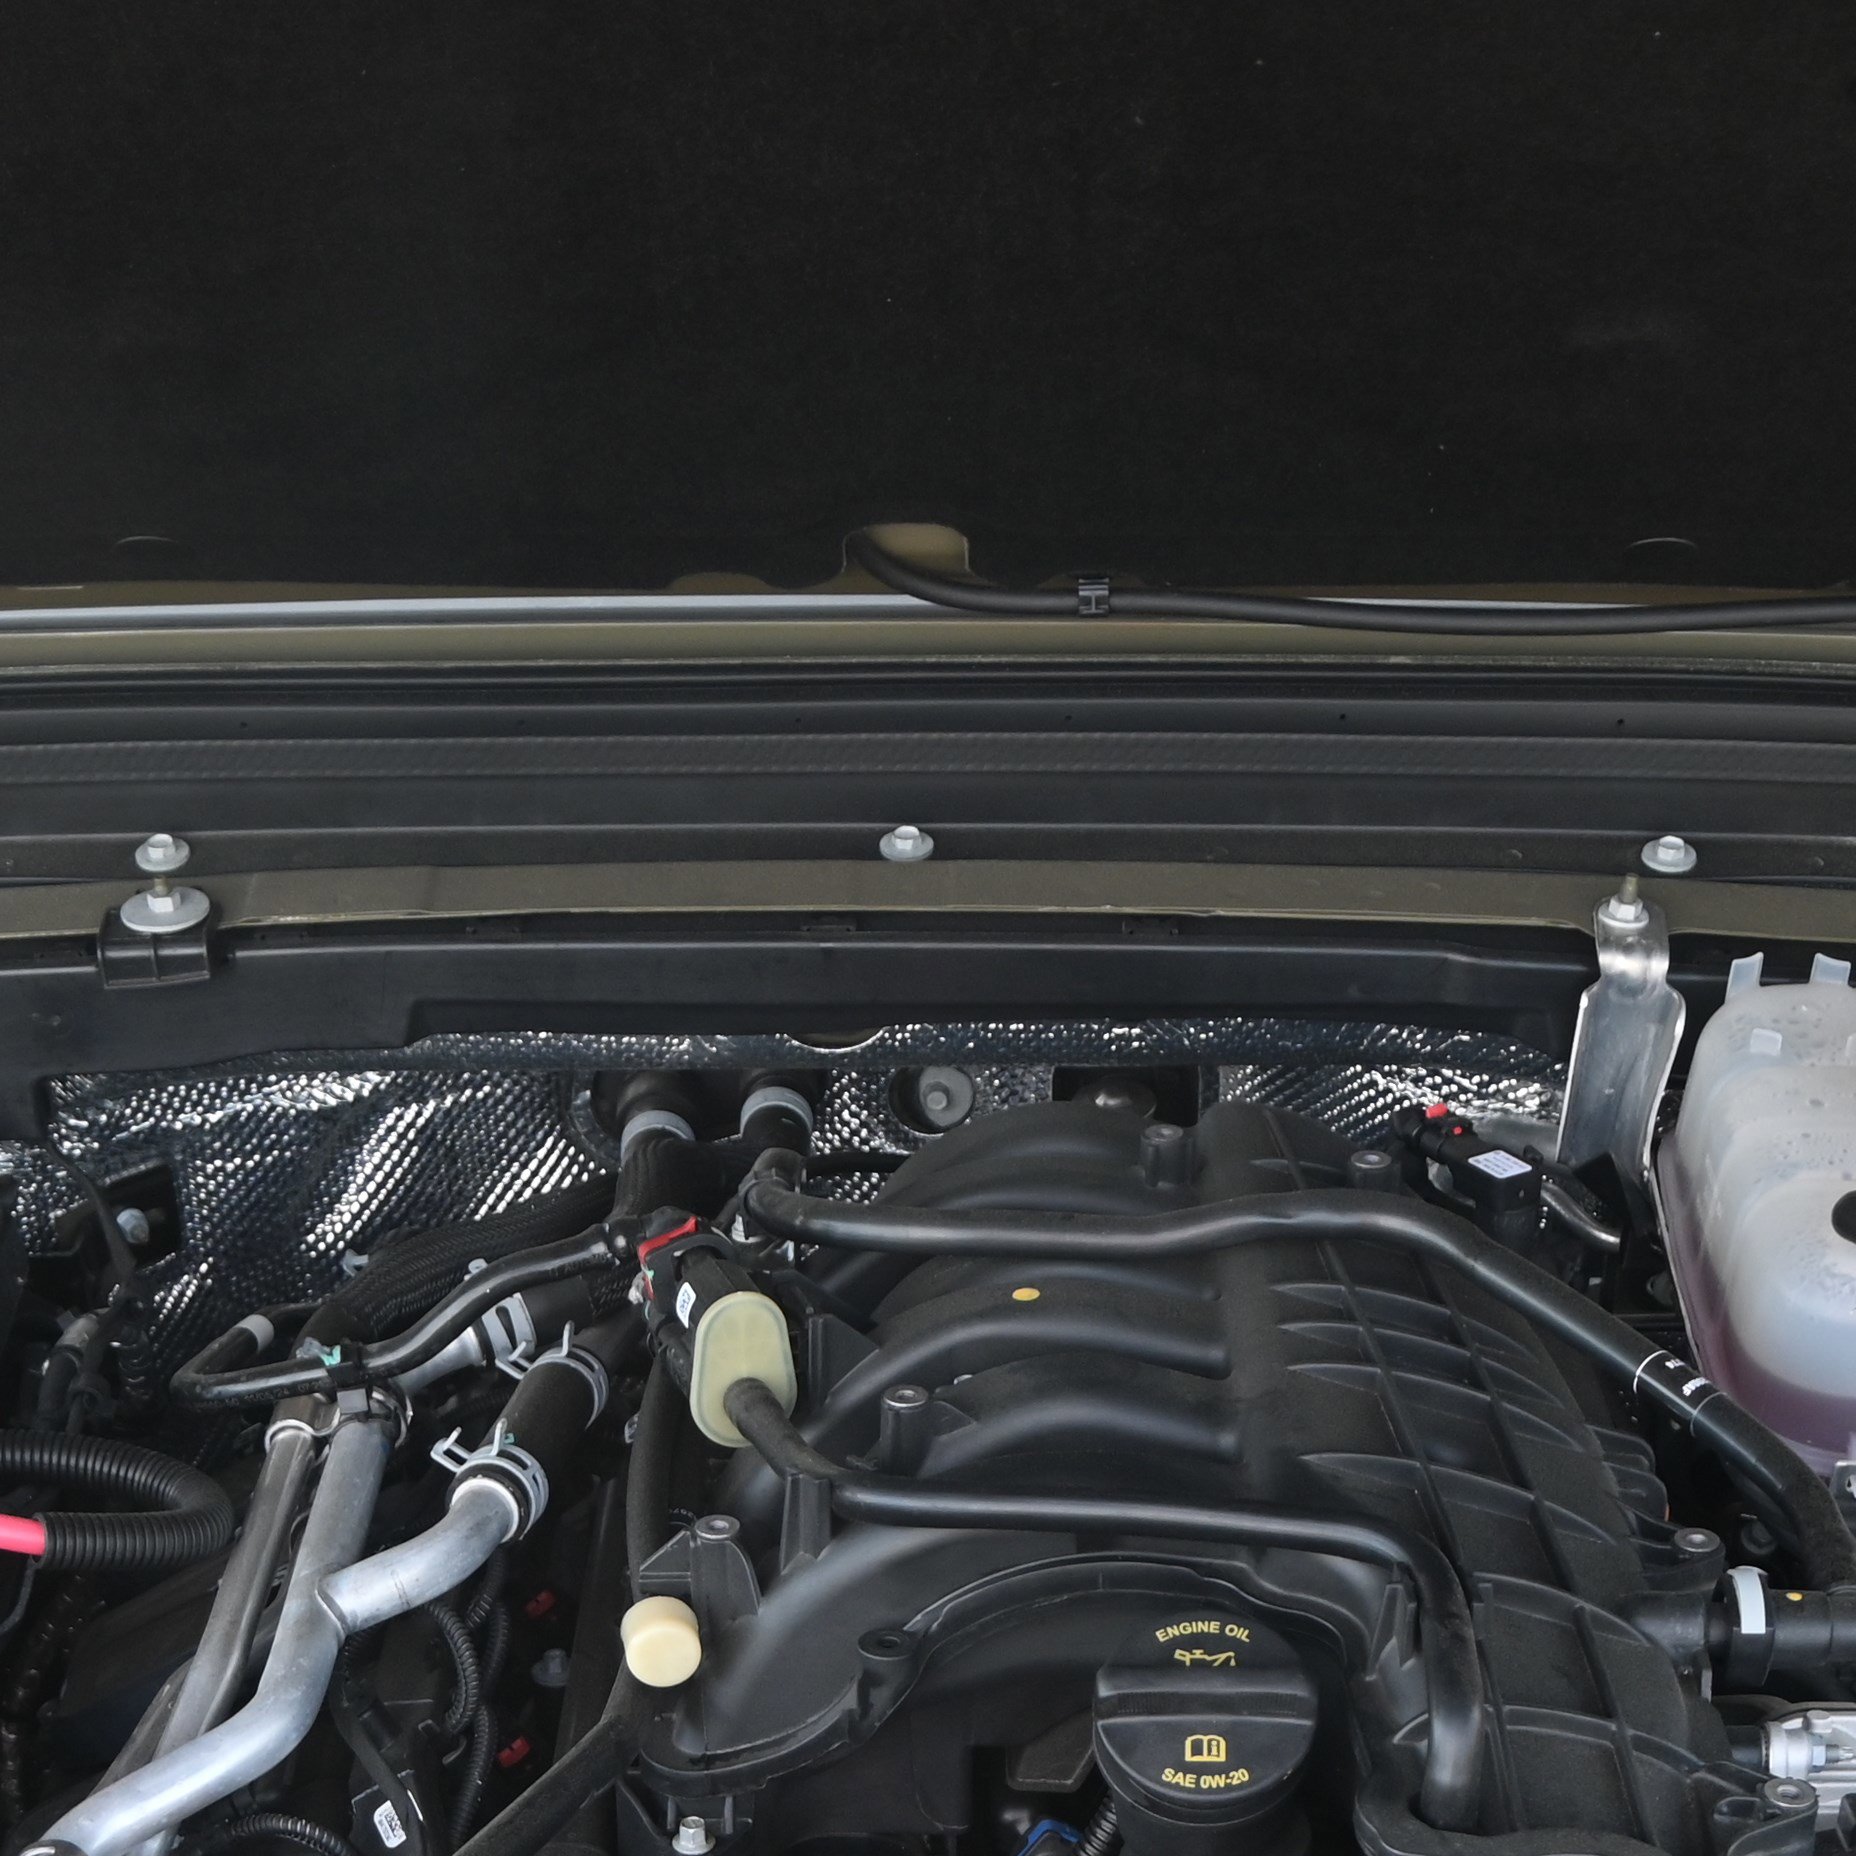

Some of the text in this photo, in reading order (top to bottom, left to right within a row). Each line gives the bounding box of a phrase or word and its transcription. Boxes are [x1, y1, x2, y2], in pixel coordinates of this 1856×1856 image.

[1155, 1620, 1251, 1642] ENGINE OIL
[1162, 1768, 1250, 1789] SAE 0W-20
